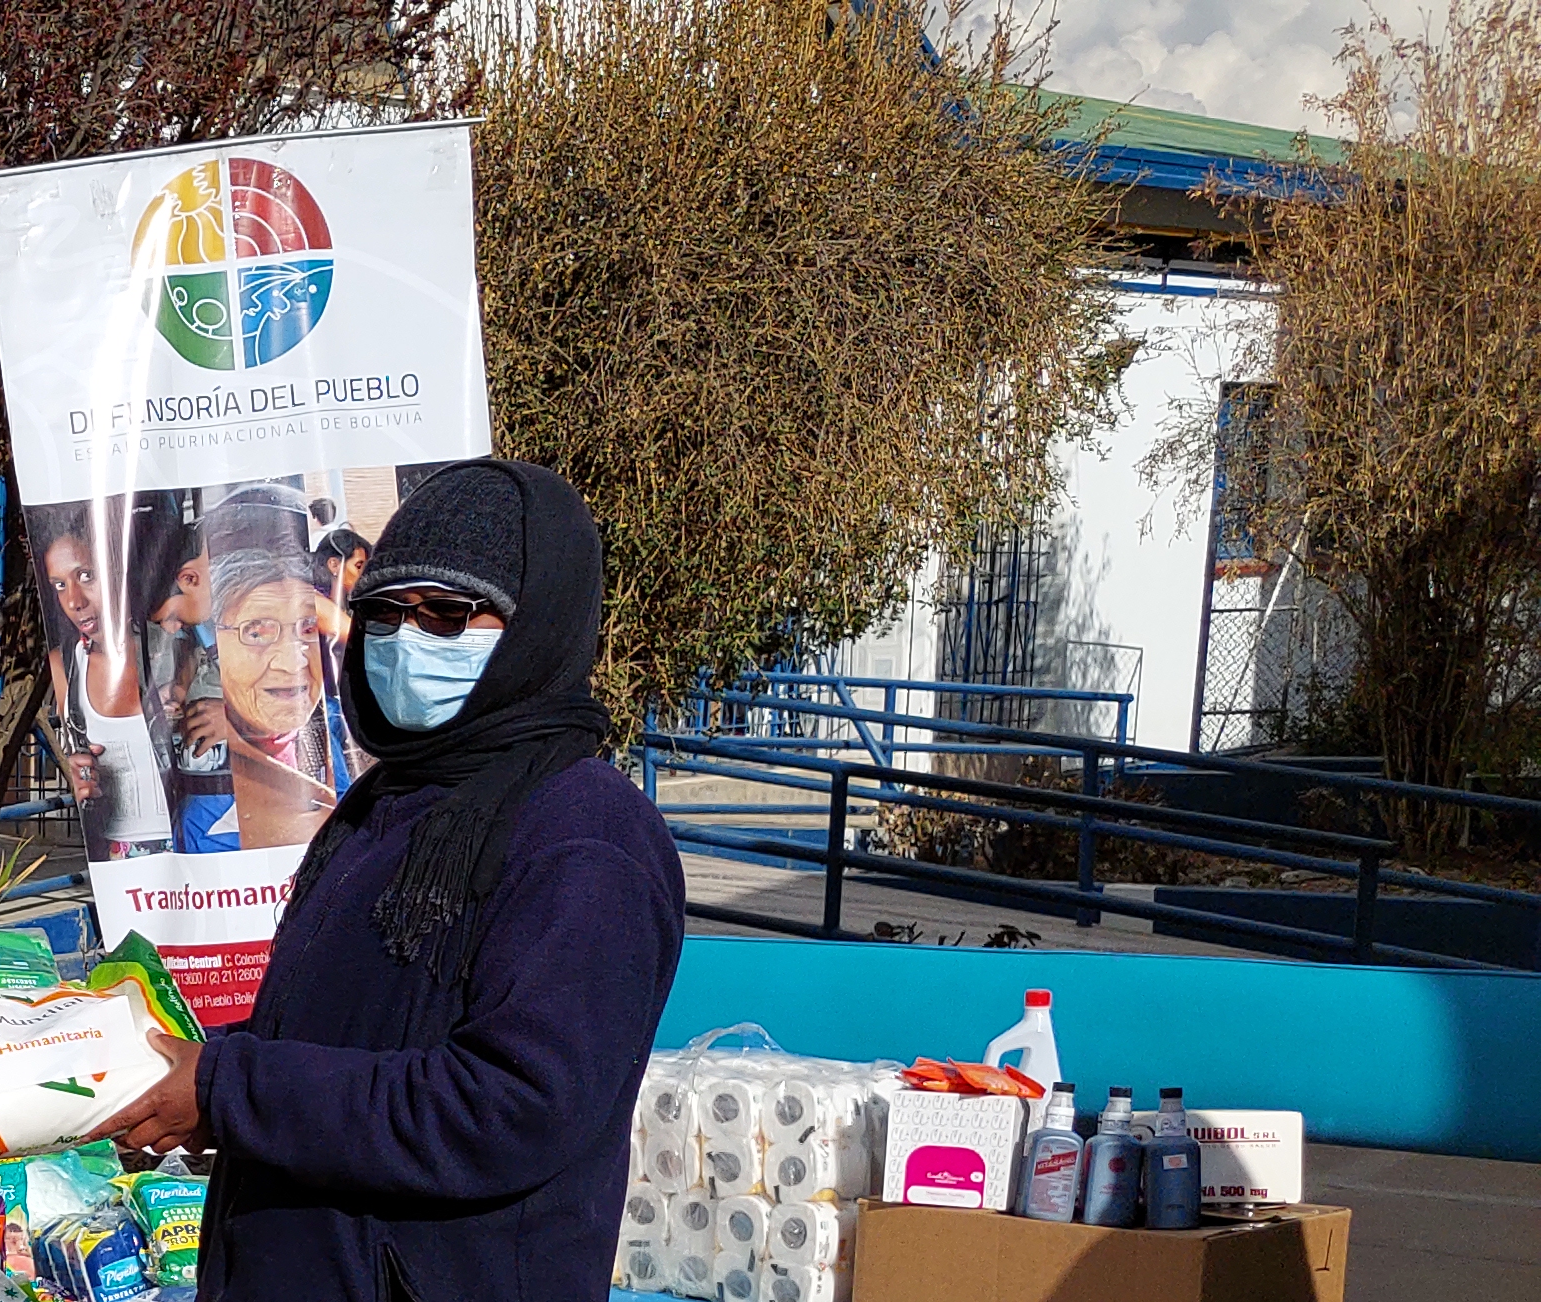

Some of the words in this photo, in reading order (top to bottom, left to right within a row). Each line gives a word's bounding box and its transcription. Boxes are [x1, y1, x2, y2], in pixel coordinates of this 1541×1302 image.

[250, 383, 306, 413] DEL
[314, 373, 420, 404] PUEBLO
[158, 420, 309, 449] PLURINACIONAL
[320, 416, 342, 431] DE
[349, 410, 423, 430] BOLIVIA
[125, 876, 296, 912] Transformand
[188, 955, 222, 969] Central
[234, 952, 271, 966] Colombi
[205, 993, 233, 1007] Pueblo
[1187, 1127, 1250, 1140] UIBOL
[148, 1187, 203, 1205] Plenitud
[1220, 1186, 1245, 1197] 500
[1250, 1188, 1268, 1199] mg
